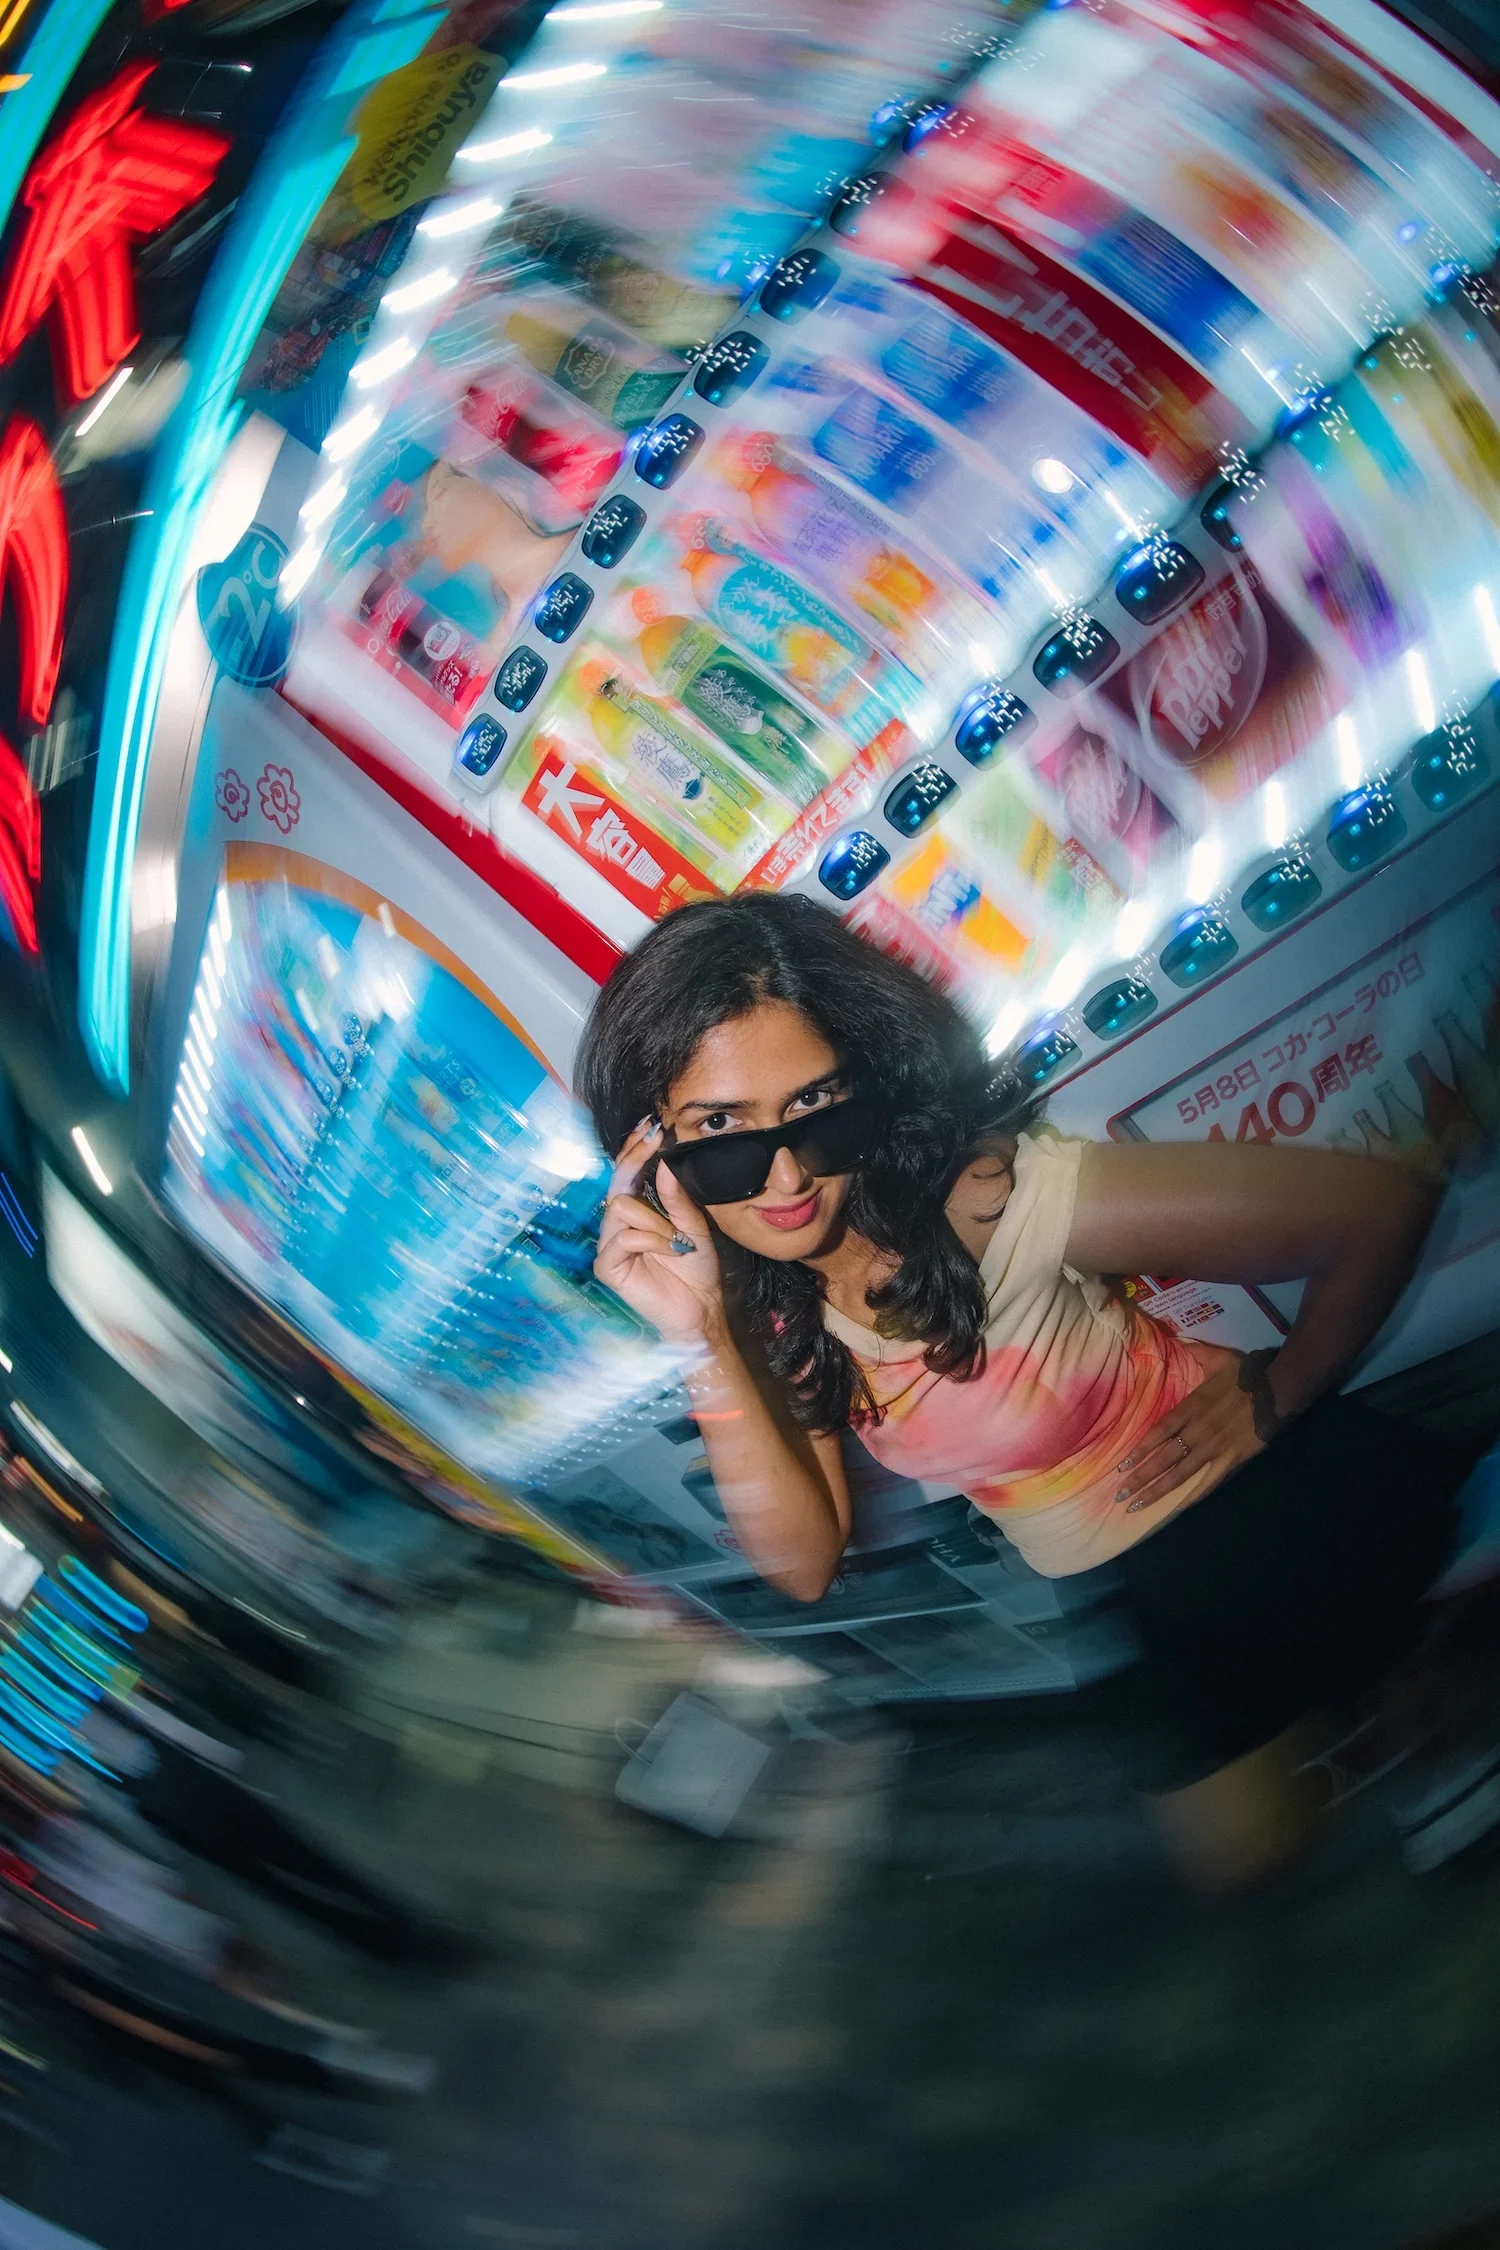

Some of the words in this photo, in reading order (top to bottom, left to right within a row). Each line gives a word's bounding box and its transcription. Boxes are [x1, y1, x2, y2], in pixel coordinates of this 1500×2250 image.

[362, 80, 445, 188] welcome
[380, 60, 492, 203] Shibuya
[566, 332, 608, 385] CANADA
[583, 351, 605, 378] DRY
[696, 671, 753, 728] 綾鷹
[1160, 641, 1250, 750] Pepper
[627, 723, 696, 791] 綾鷹
[537, 762, 668, 889] 大容量
[1175, 1061, 1261, 1123] 5月8日
[1262, 954, 1426, 1070] コカ・コーラの日
[1153, 1293, 1170, 1302] Code
